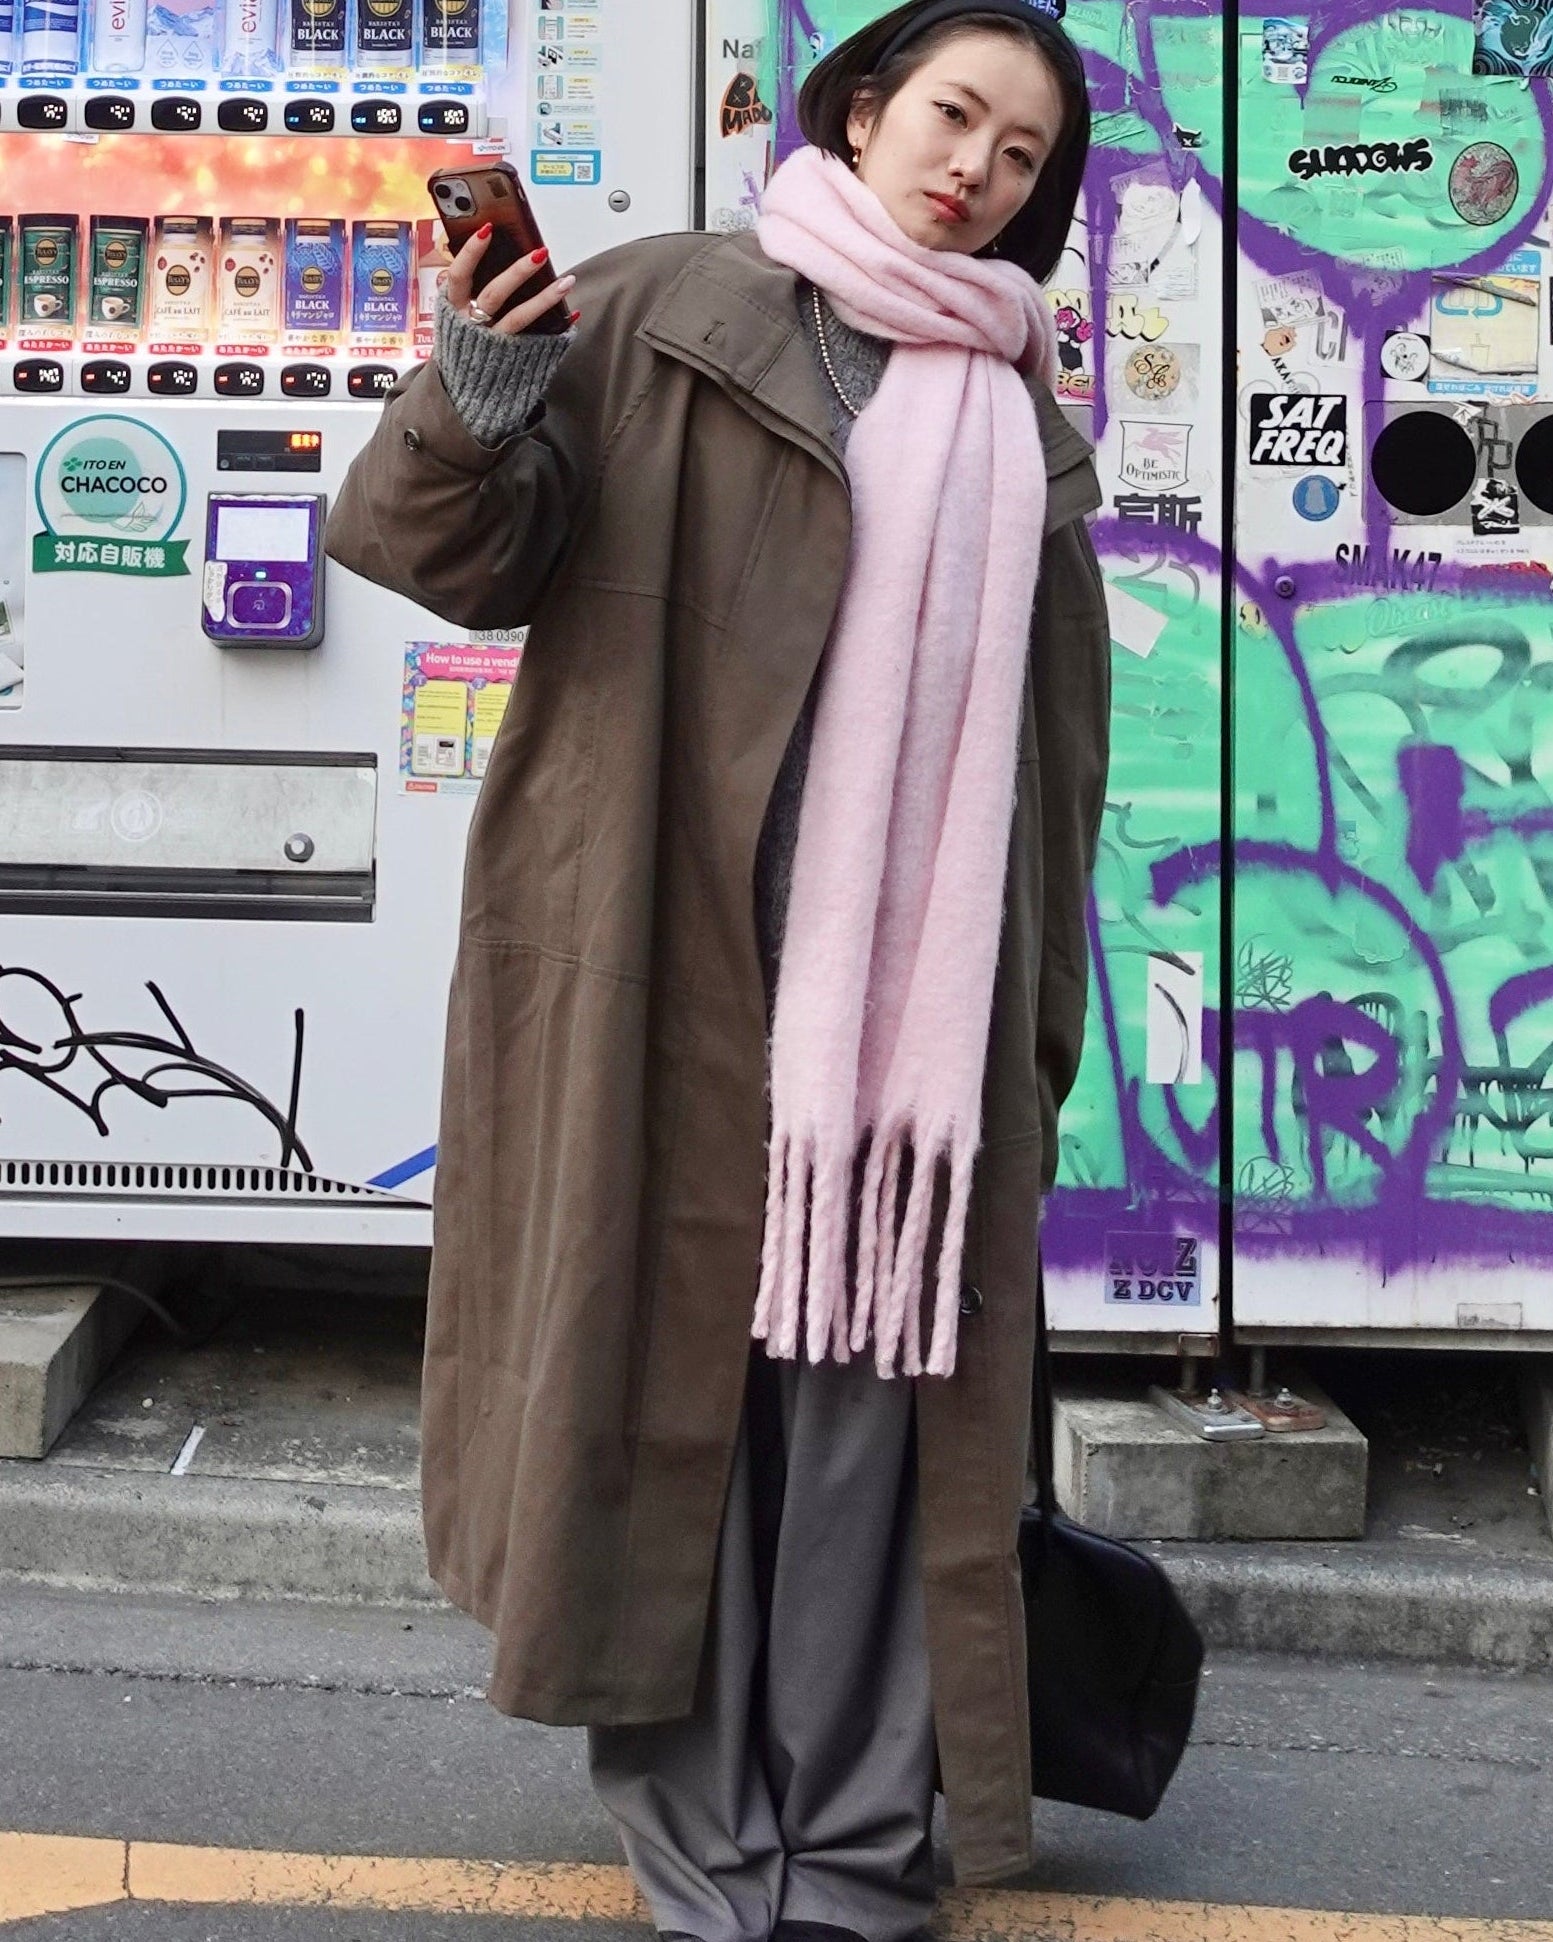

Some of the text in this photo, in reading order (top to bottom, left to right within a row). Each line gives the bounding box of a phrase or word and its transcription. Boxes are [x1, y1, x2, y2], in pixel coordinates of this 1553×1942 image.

[298, 28, 338, 40] BLACK
[364, 28, 405, 40] BLACK
[430, 26, 472, 38] BLACK
[24, 275, 69, 285] ESPRESSO
[94, 277, 137, 287] ESPRESSO
[295, 300, 329, 310] BLACK
[364, 302, 398, 312] BLACK
[1258, 395, 1343, 430] SAT
[1250, 429, 1345, 464] FREQ
[83, 460, 126, 470] ITO EN
[1144, 458, 1159, 469] BE
[61, 476, 167, 494] CHACOCO
[55, 541, 165, 568] 対応自販機
[426, 653, 450, 665] How
[451, 655, 461, 664] to
[463, 656, 482, 666] use
[483, 658, 490, 667] a
[1138, 1280, 1194, 1301] DCV
